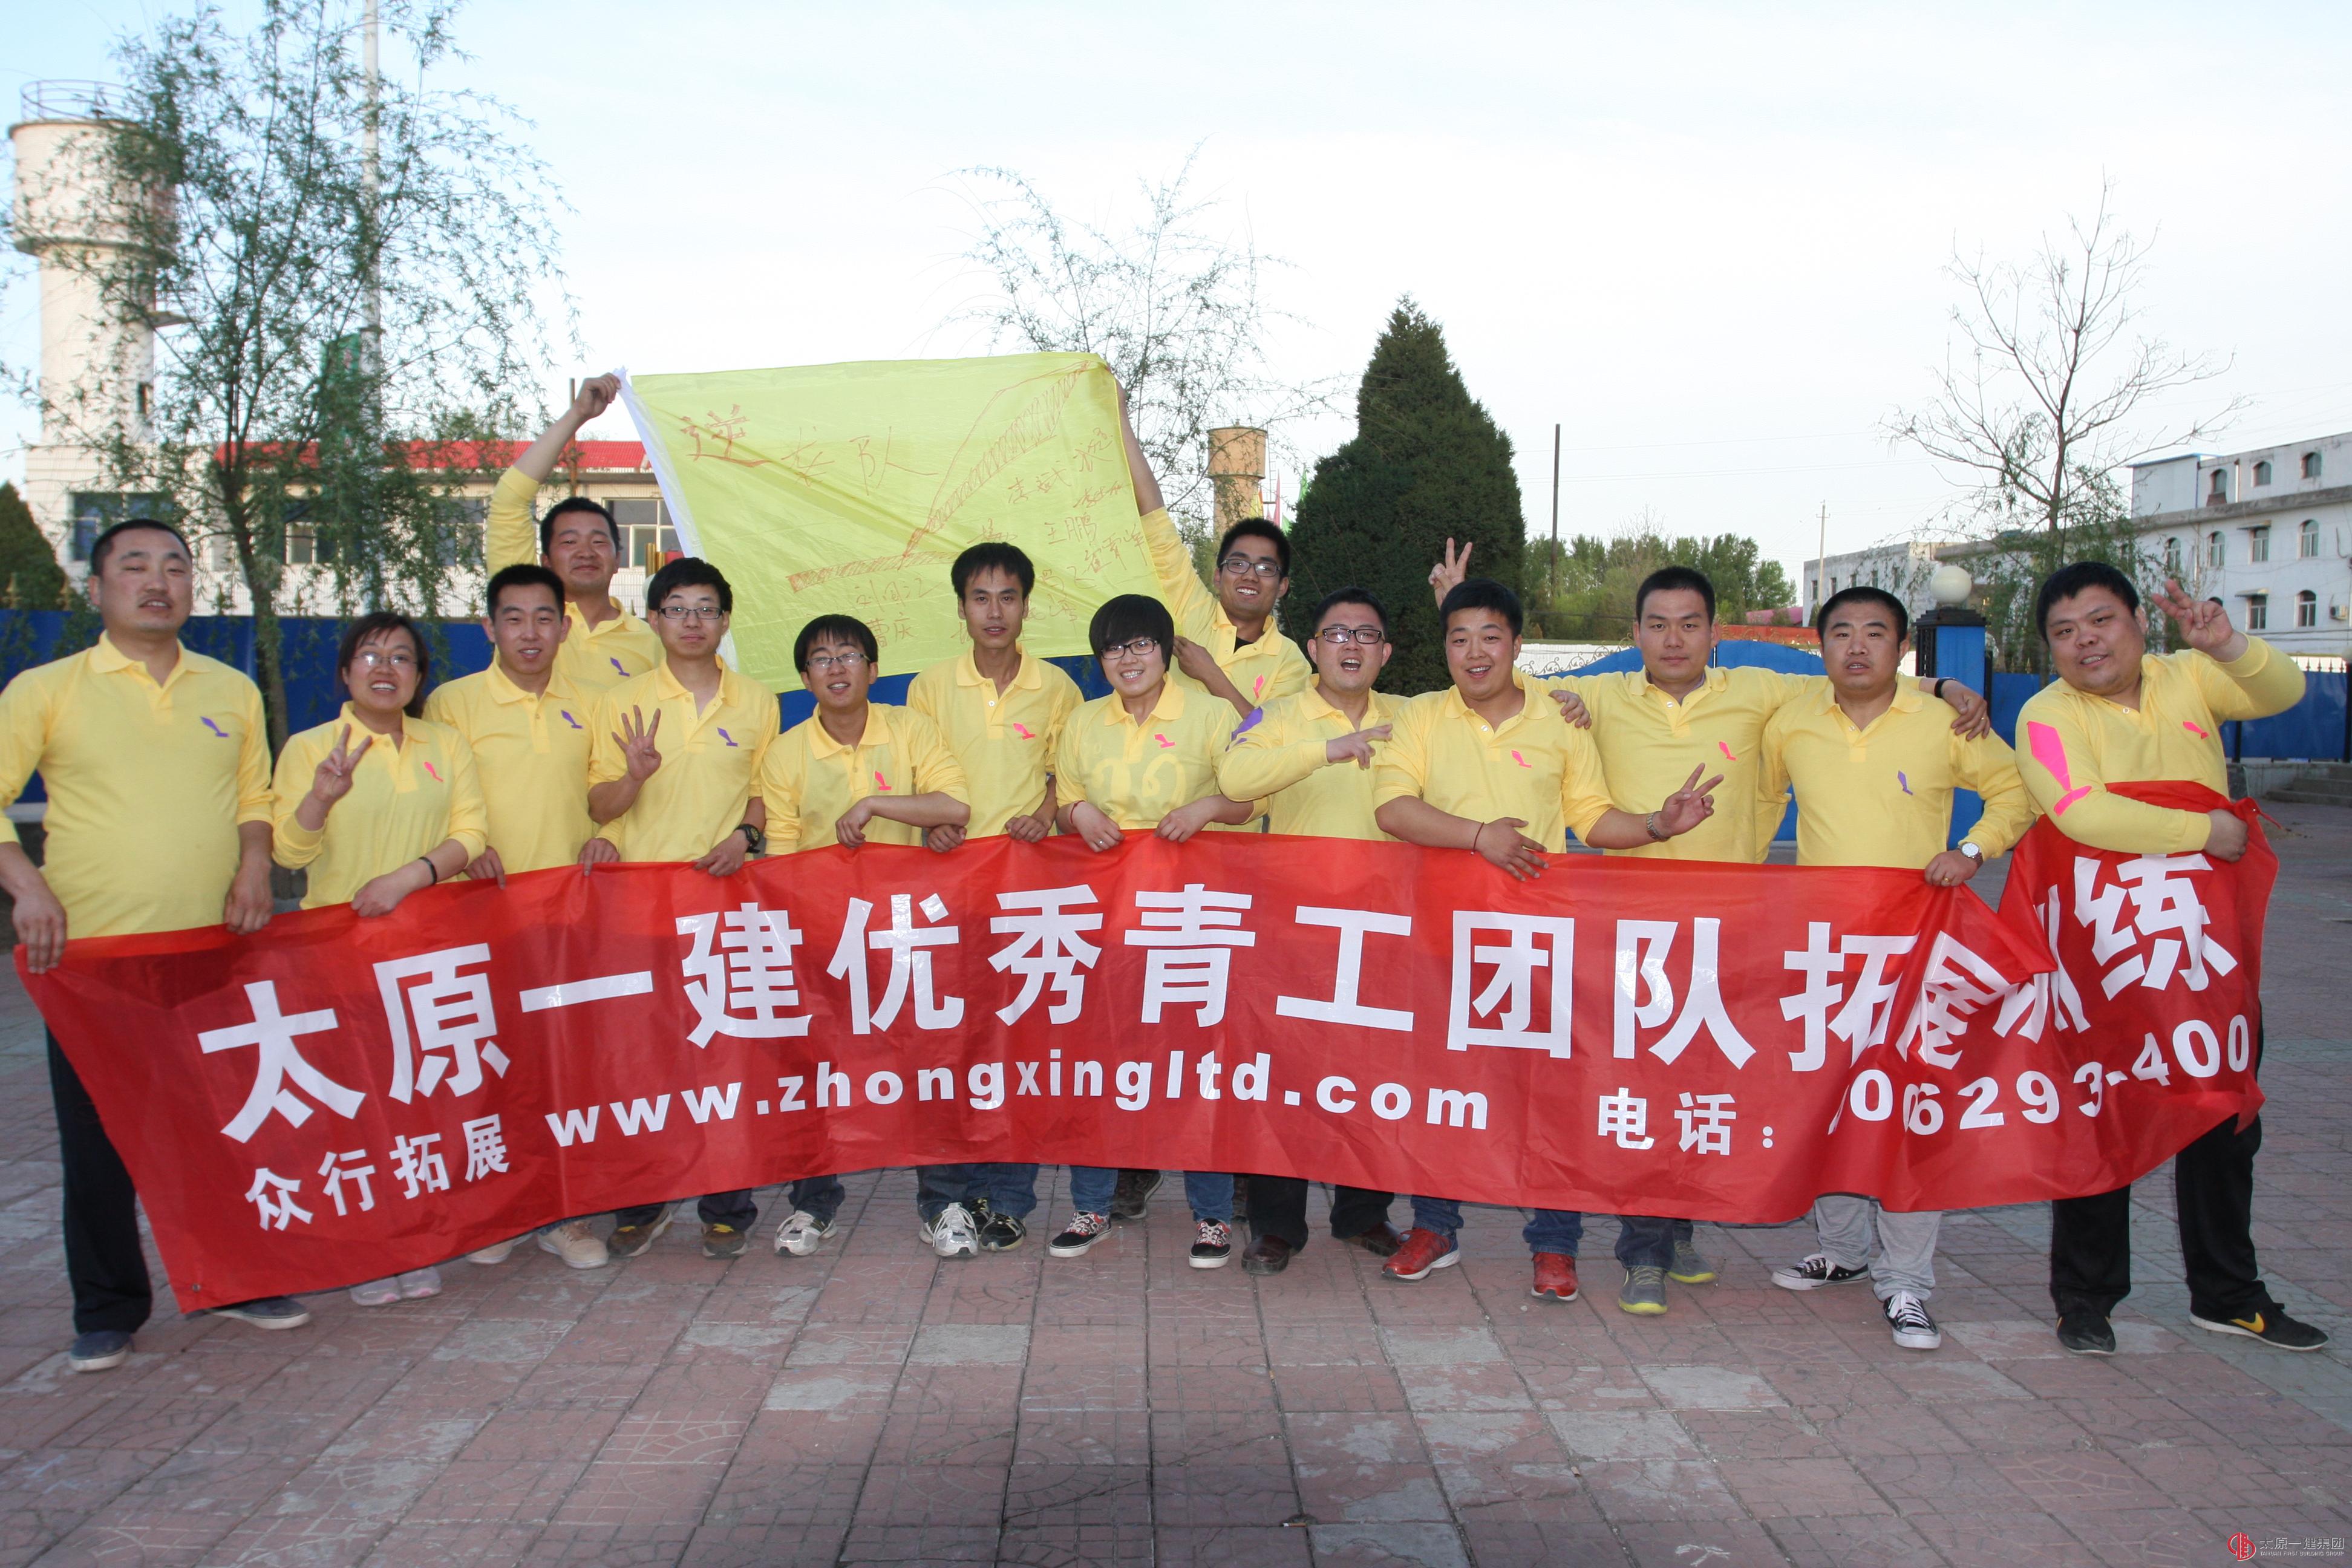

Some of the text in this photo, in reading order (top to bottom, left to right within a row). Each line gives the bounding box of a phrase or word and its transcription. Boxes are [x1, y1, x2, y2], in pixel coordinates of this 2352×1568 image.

[544, 1048, 1489, 1148] www.zhongxingltd.com
[245, 1113, 510, 1230] 众行拓展
